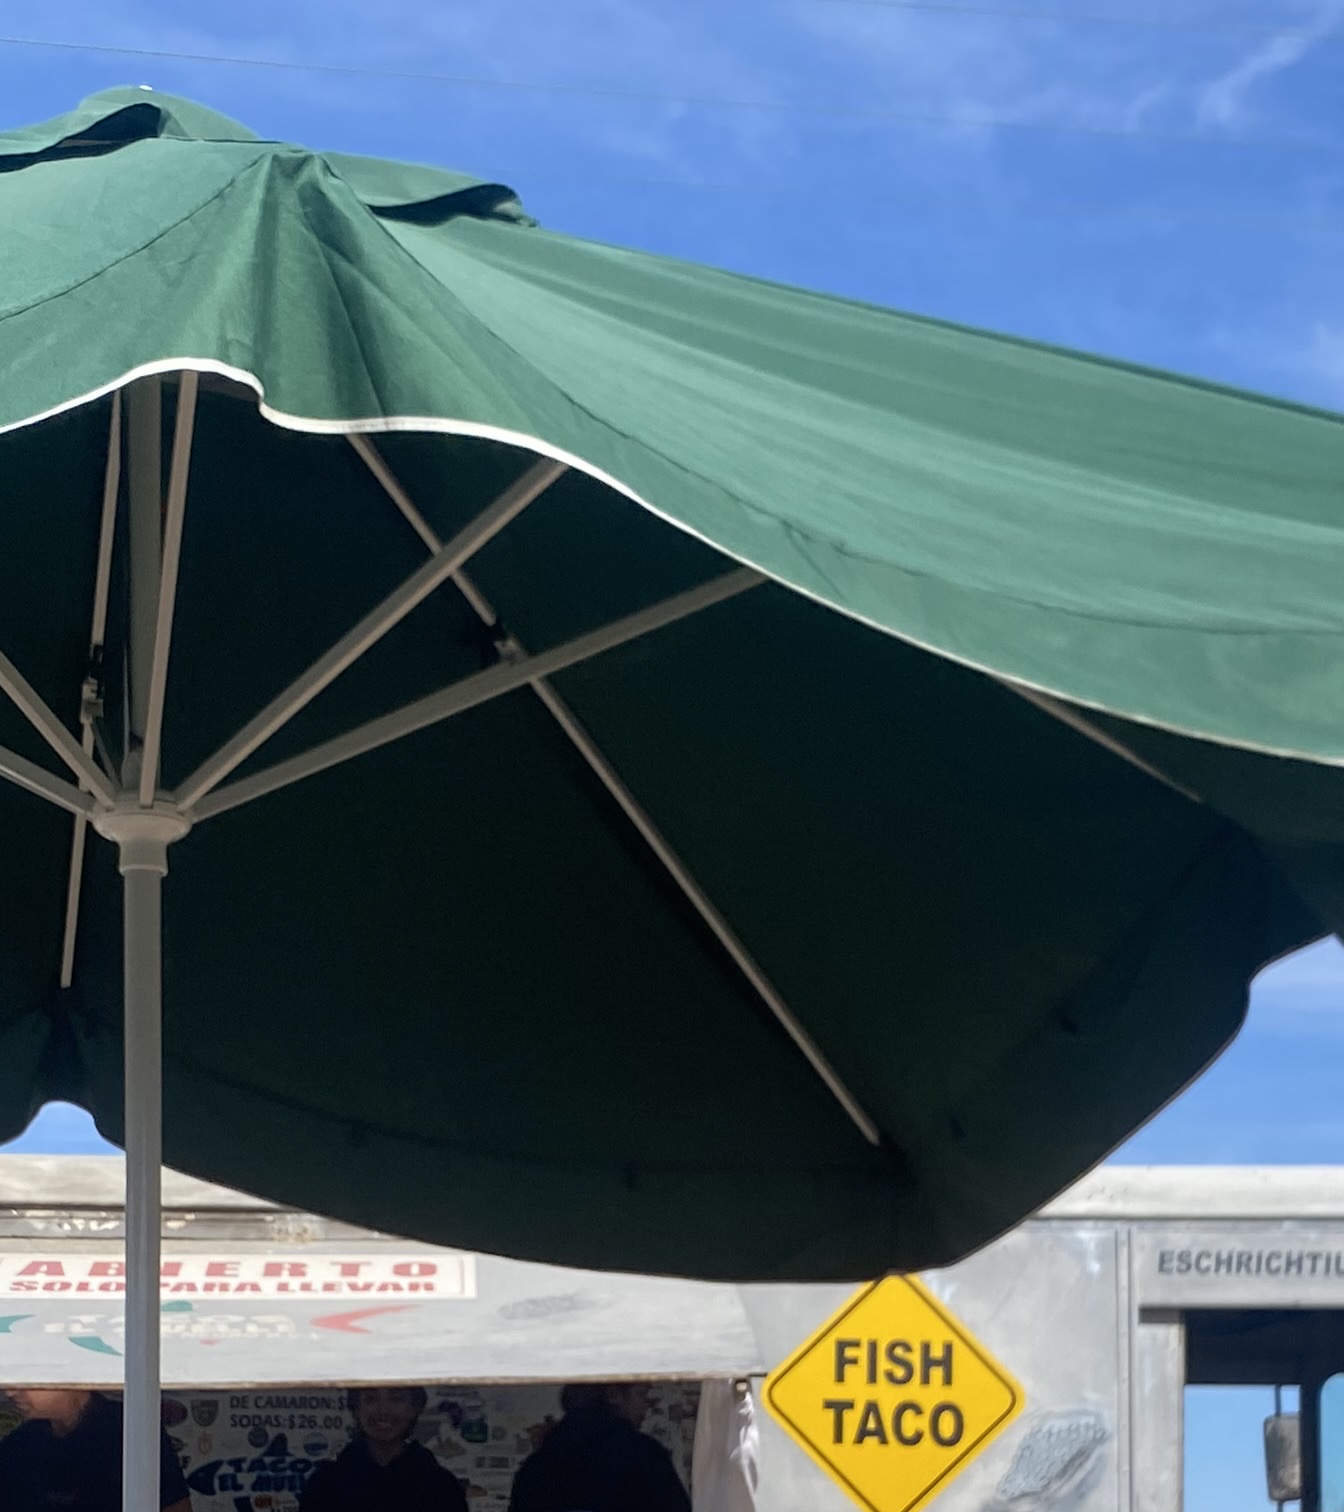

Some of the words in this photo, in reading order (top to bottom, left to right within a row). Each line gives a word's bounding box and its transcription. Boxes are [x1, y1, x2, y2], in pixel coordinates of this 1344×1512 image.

[17, 1261, 438, 1277] ABIERTO
[10, 1281, 126, 1292] SOLO
[277, 1282, 435, 1292] LLEVAR
[835, 1339, 954, 1386] FISH
[230, 1396, 251, 1410] DE
[823, 1399, 965, 1447] TACO
[227, 1457, 312, 1473] TACO
